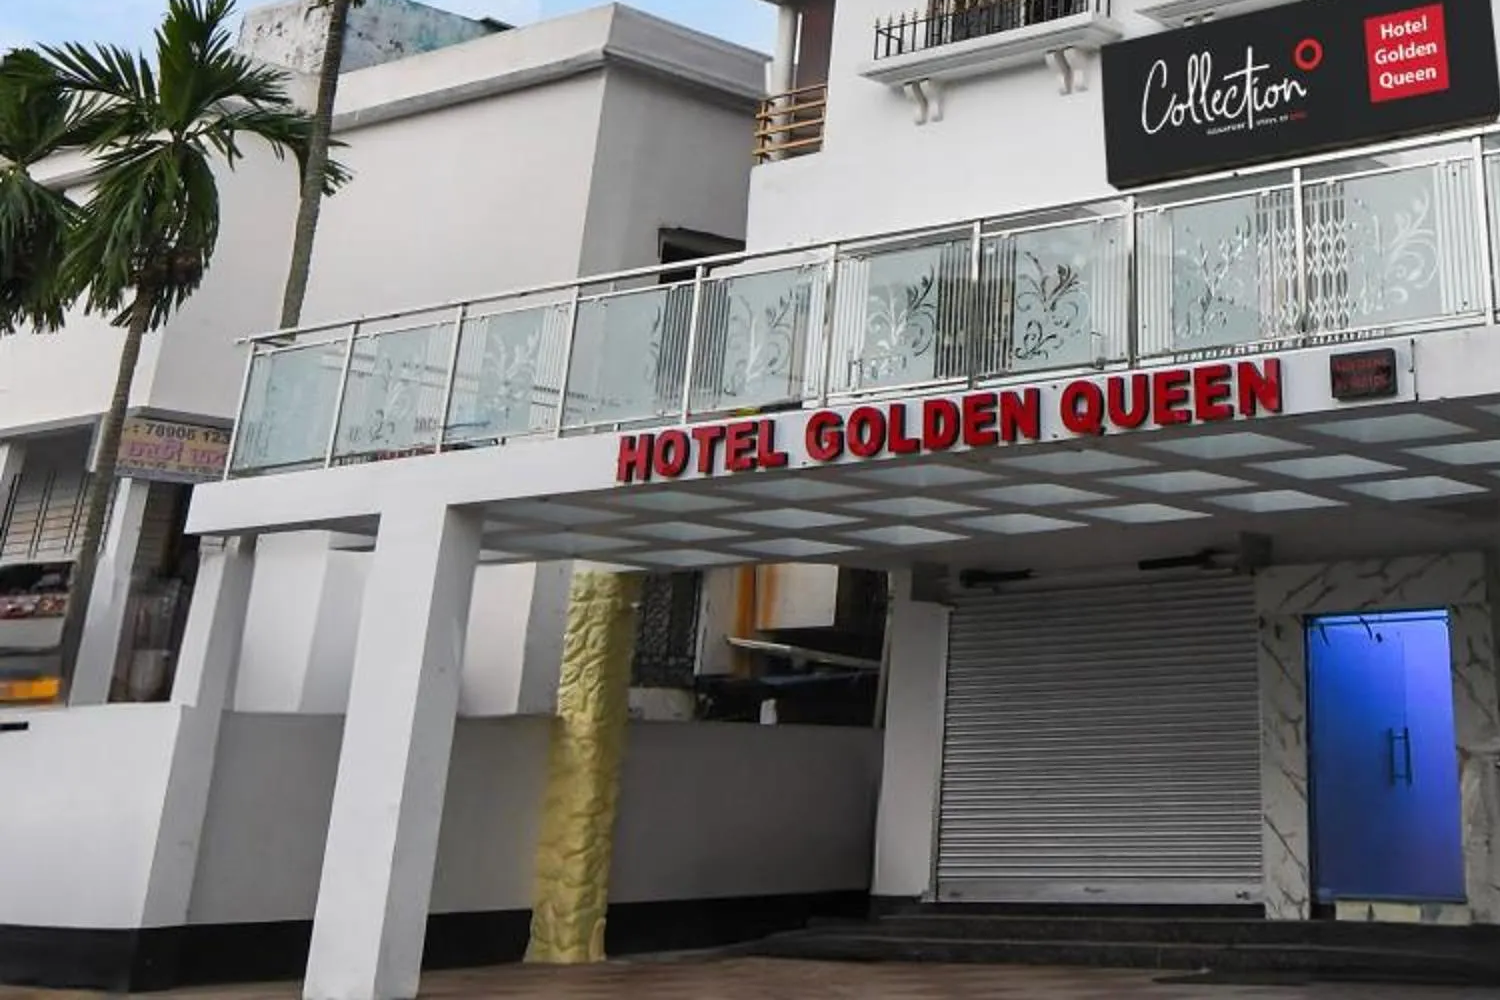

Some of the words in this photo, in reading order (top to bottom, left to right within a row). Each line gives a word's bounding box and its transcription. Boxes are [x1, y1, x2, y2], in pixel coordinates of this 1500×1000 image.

[1380, 14, 1427, 40] Hotel
[1375, 41, 1438, 65] Golden
[1142, 45, 1307, 134] Collection
[1379, 66, 1438, 89] Queen
[615, 419, 788, 483] HOTEL
[805, 387, 1041, 462] GOLDEN
[1060, 357, 1281, 436] QUEEN
